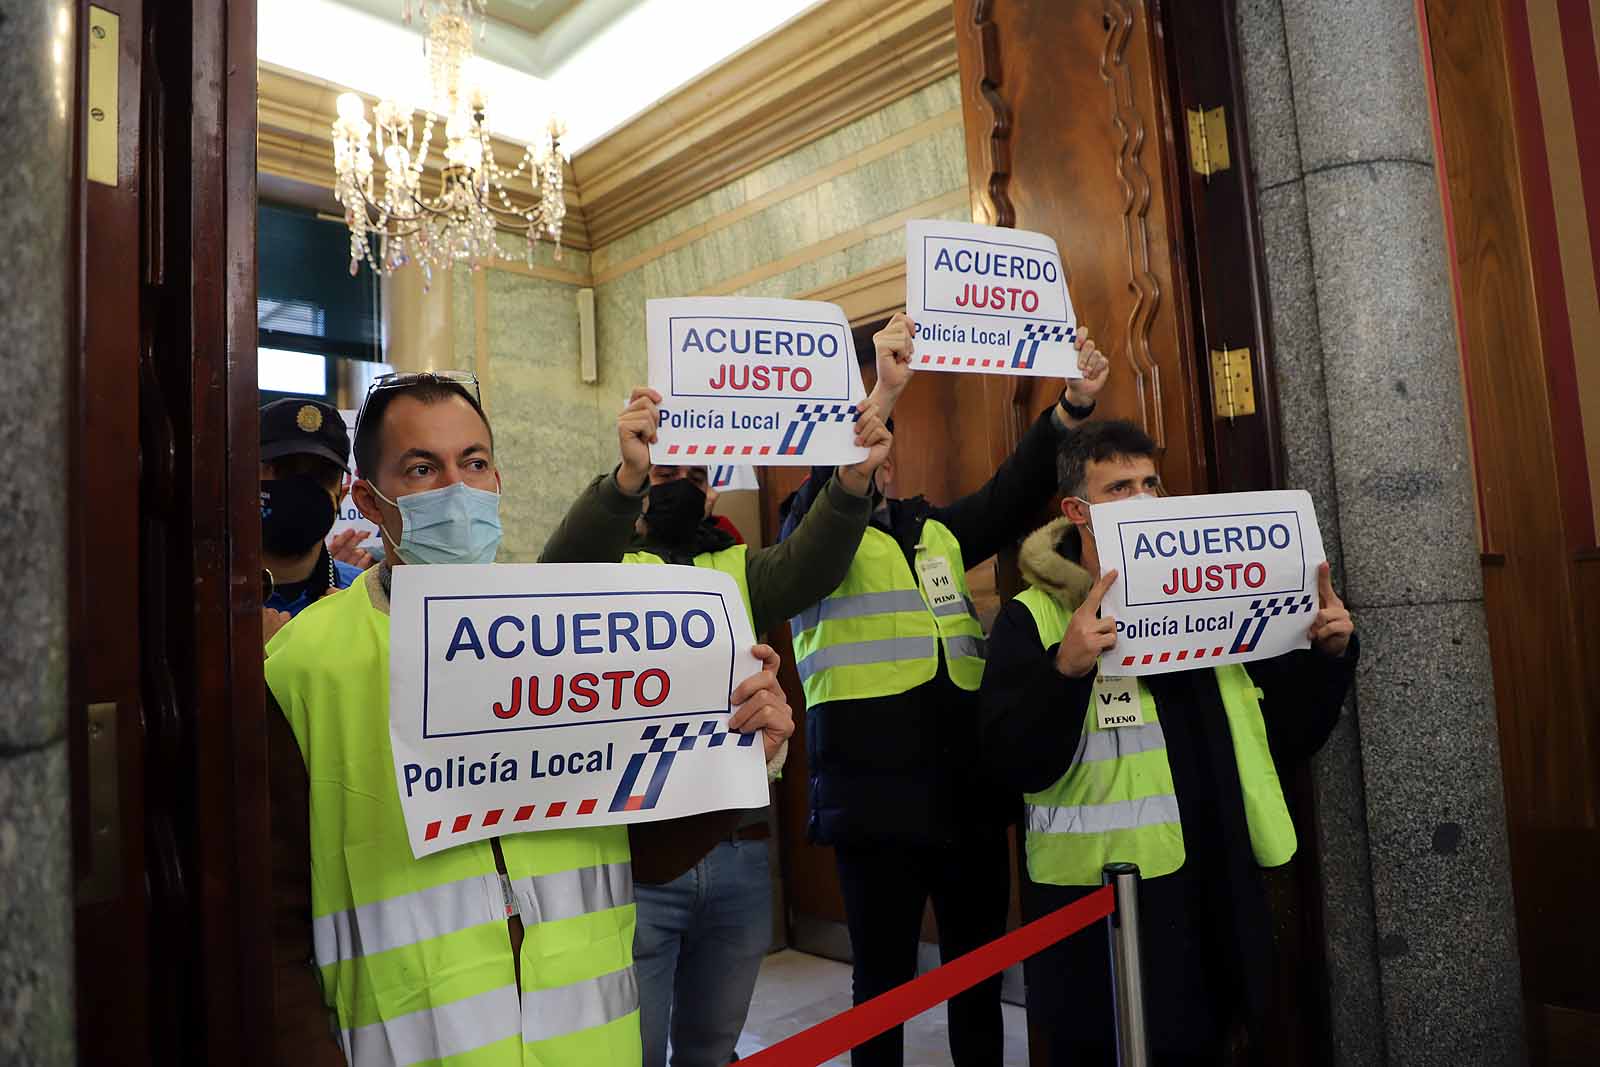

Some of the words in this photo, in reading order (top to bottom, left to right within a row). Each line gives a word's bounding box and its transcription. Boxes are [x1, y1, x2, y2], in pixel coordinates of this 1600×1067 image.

[934, 248, 1058, 283] ACUERDO
[955, 283, 1039, 313] JUSTO
[681, 328, 839, 358] ACUERDO
[912, 322, 966, 343] Policía
[971, 327, 1010, 346] Local
[709, 364, 812, 392] JUSTO
[658, 409, 724, 429] Policía
[731, 410, 780, 430] Local
[1133, 523, 1290, 560] ACUERDO
[1162, 561, 1267, 596] JUSTO
[934, 594, 956, 604] PLENO
[445, 609, 716, 662] ACUERDO
[1116, 616, 1178, 640] Policía
[1185, 611, 1233, 634] Local
[492, 668, 671, 720] JUSTO
[1099, 692, 1131, 705] V-4
[1104, 715, 1137, 725] PLENO
[403, 752, 518, 797] Policía
[531, 743, 614, 779] Local
